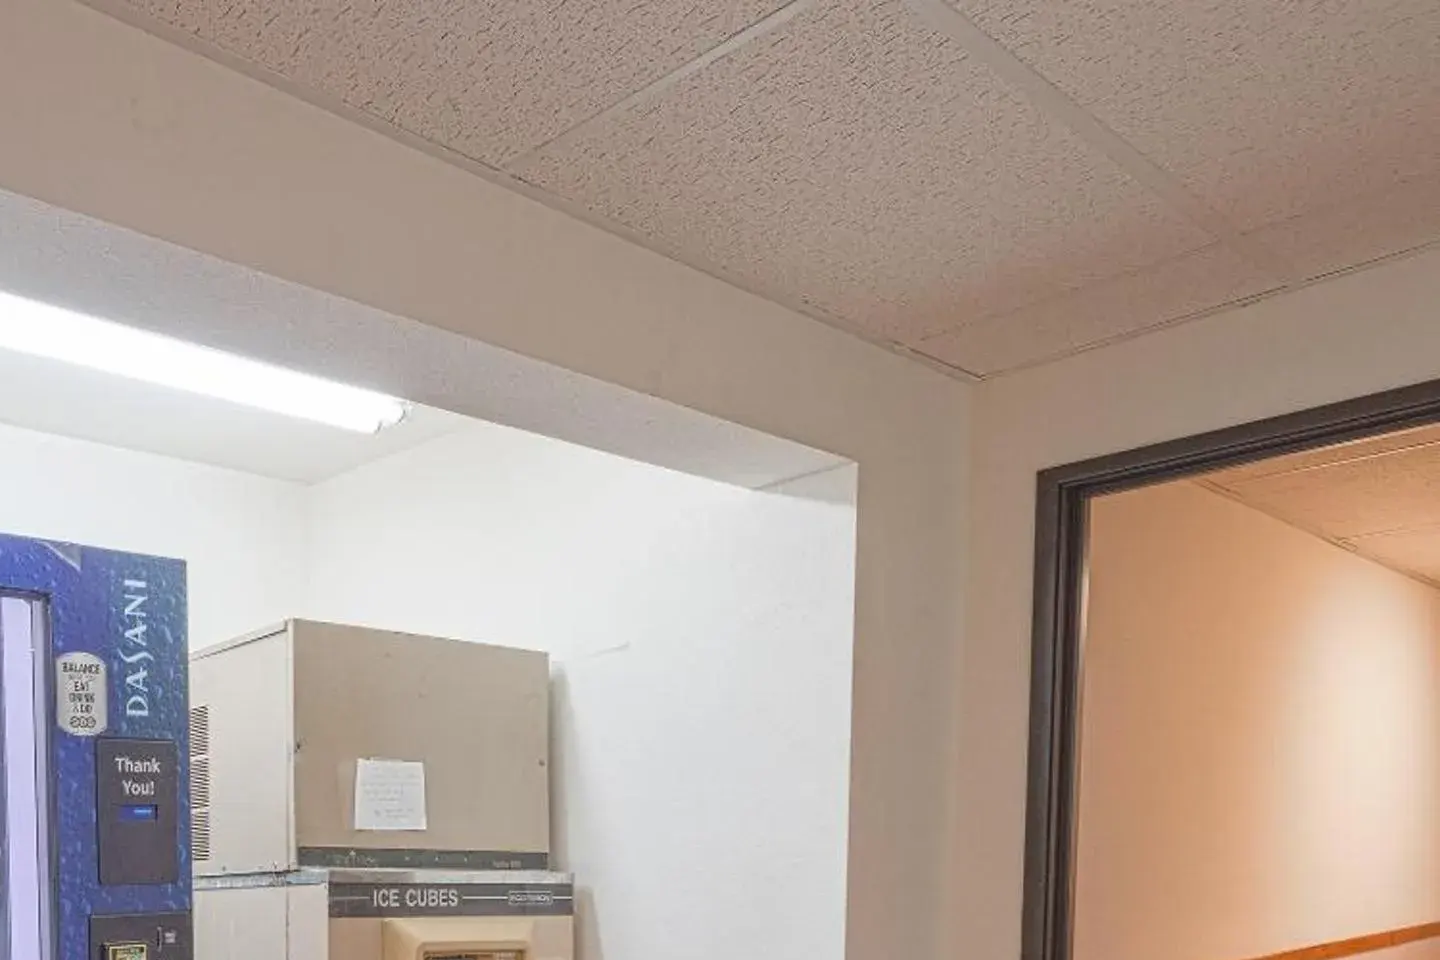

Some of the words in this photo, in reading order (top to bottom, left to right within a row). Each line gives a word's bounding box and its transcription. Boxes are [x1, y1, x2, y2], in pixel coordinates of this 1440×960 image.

[118, 578, 155, 717] DASANI
[61, 661, 101, 675] BALANCE
[114, 756, 161, 774] Thank
[122, 780, 155, 797] You!
[372, 889, 400, 907] ICE
[405, 888, 459, 908] CUBES
